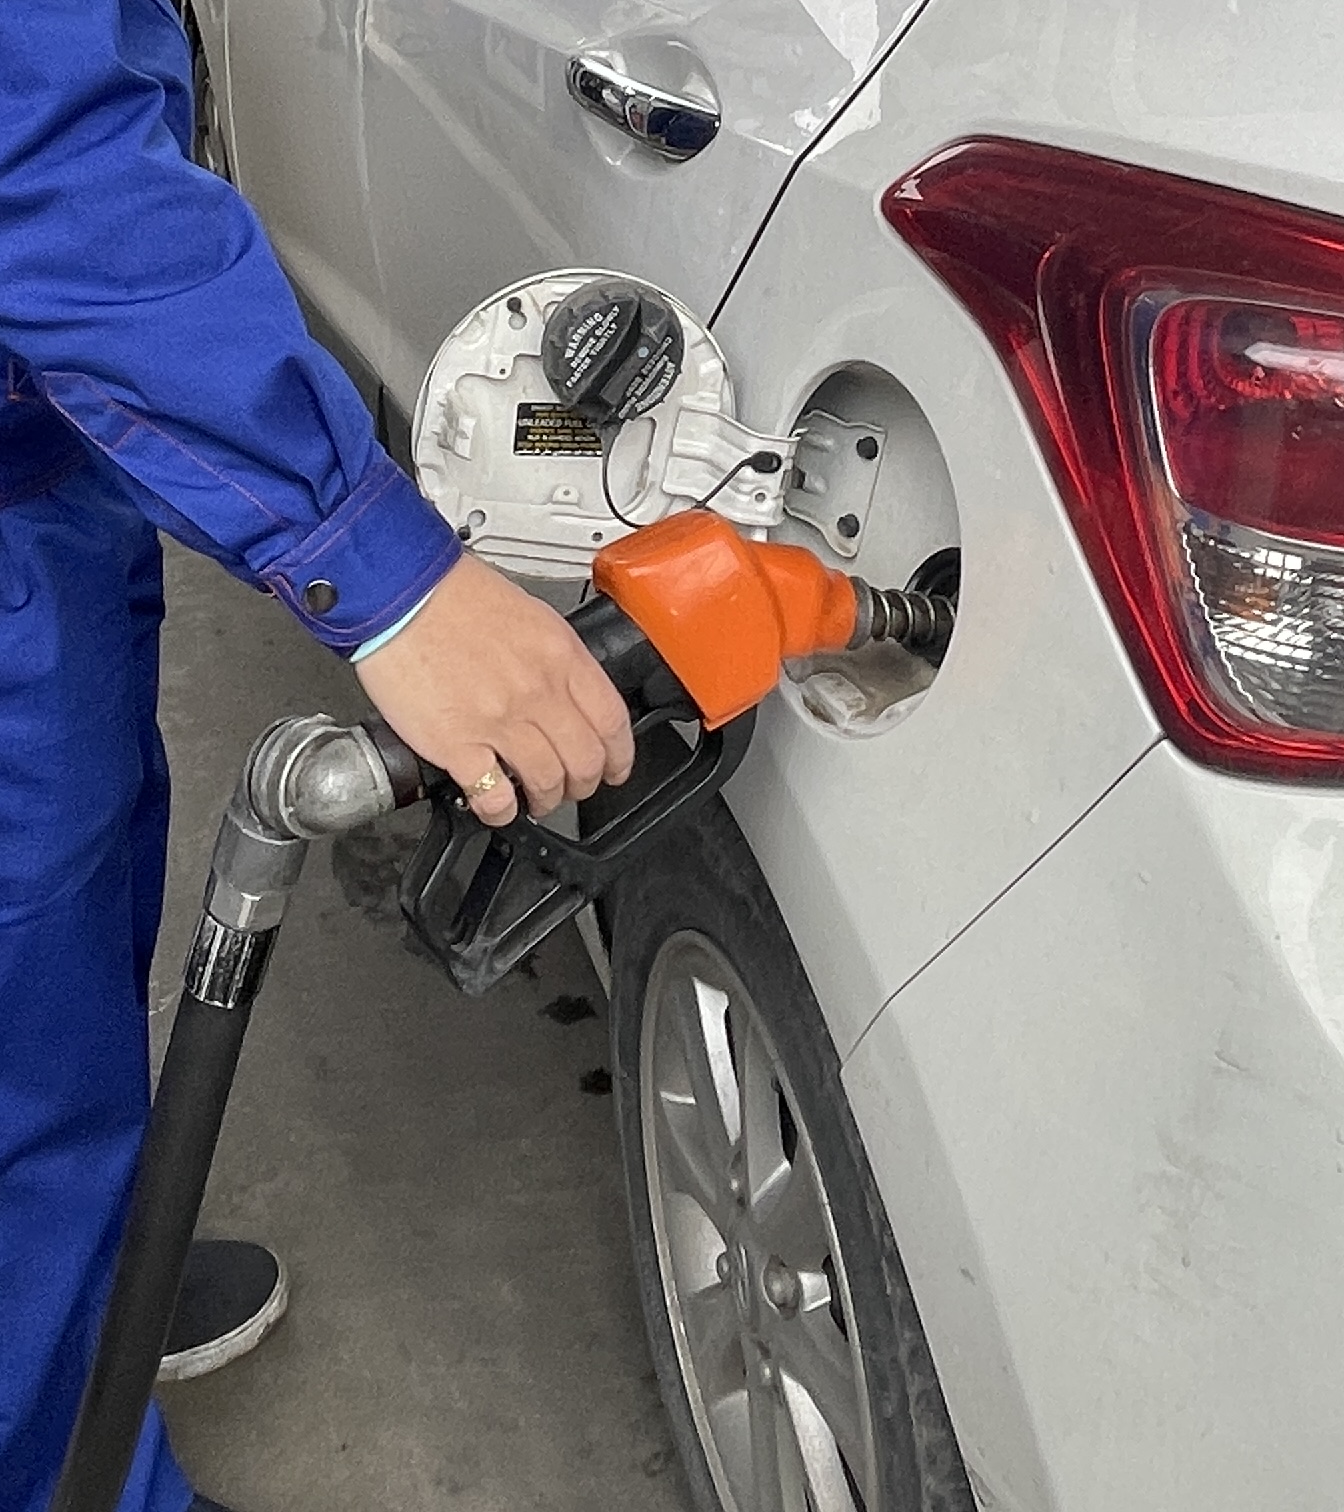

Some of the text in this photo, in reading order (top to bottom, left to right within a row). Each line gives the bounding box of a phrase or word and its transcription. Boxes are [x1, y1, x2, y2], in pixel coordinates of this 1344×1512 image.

[565, 312, 604, 358] WARNING
[594, 305, 620, 336] SLOWLY
[566, 322, 618, 388] FASTEN TIGHTLY
